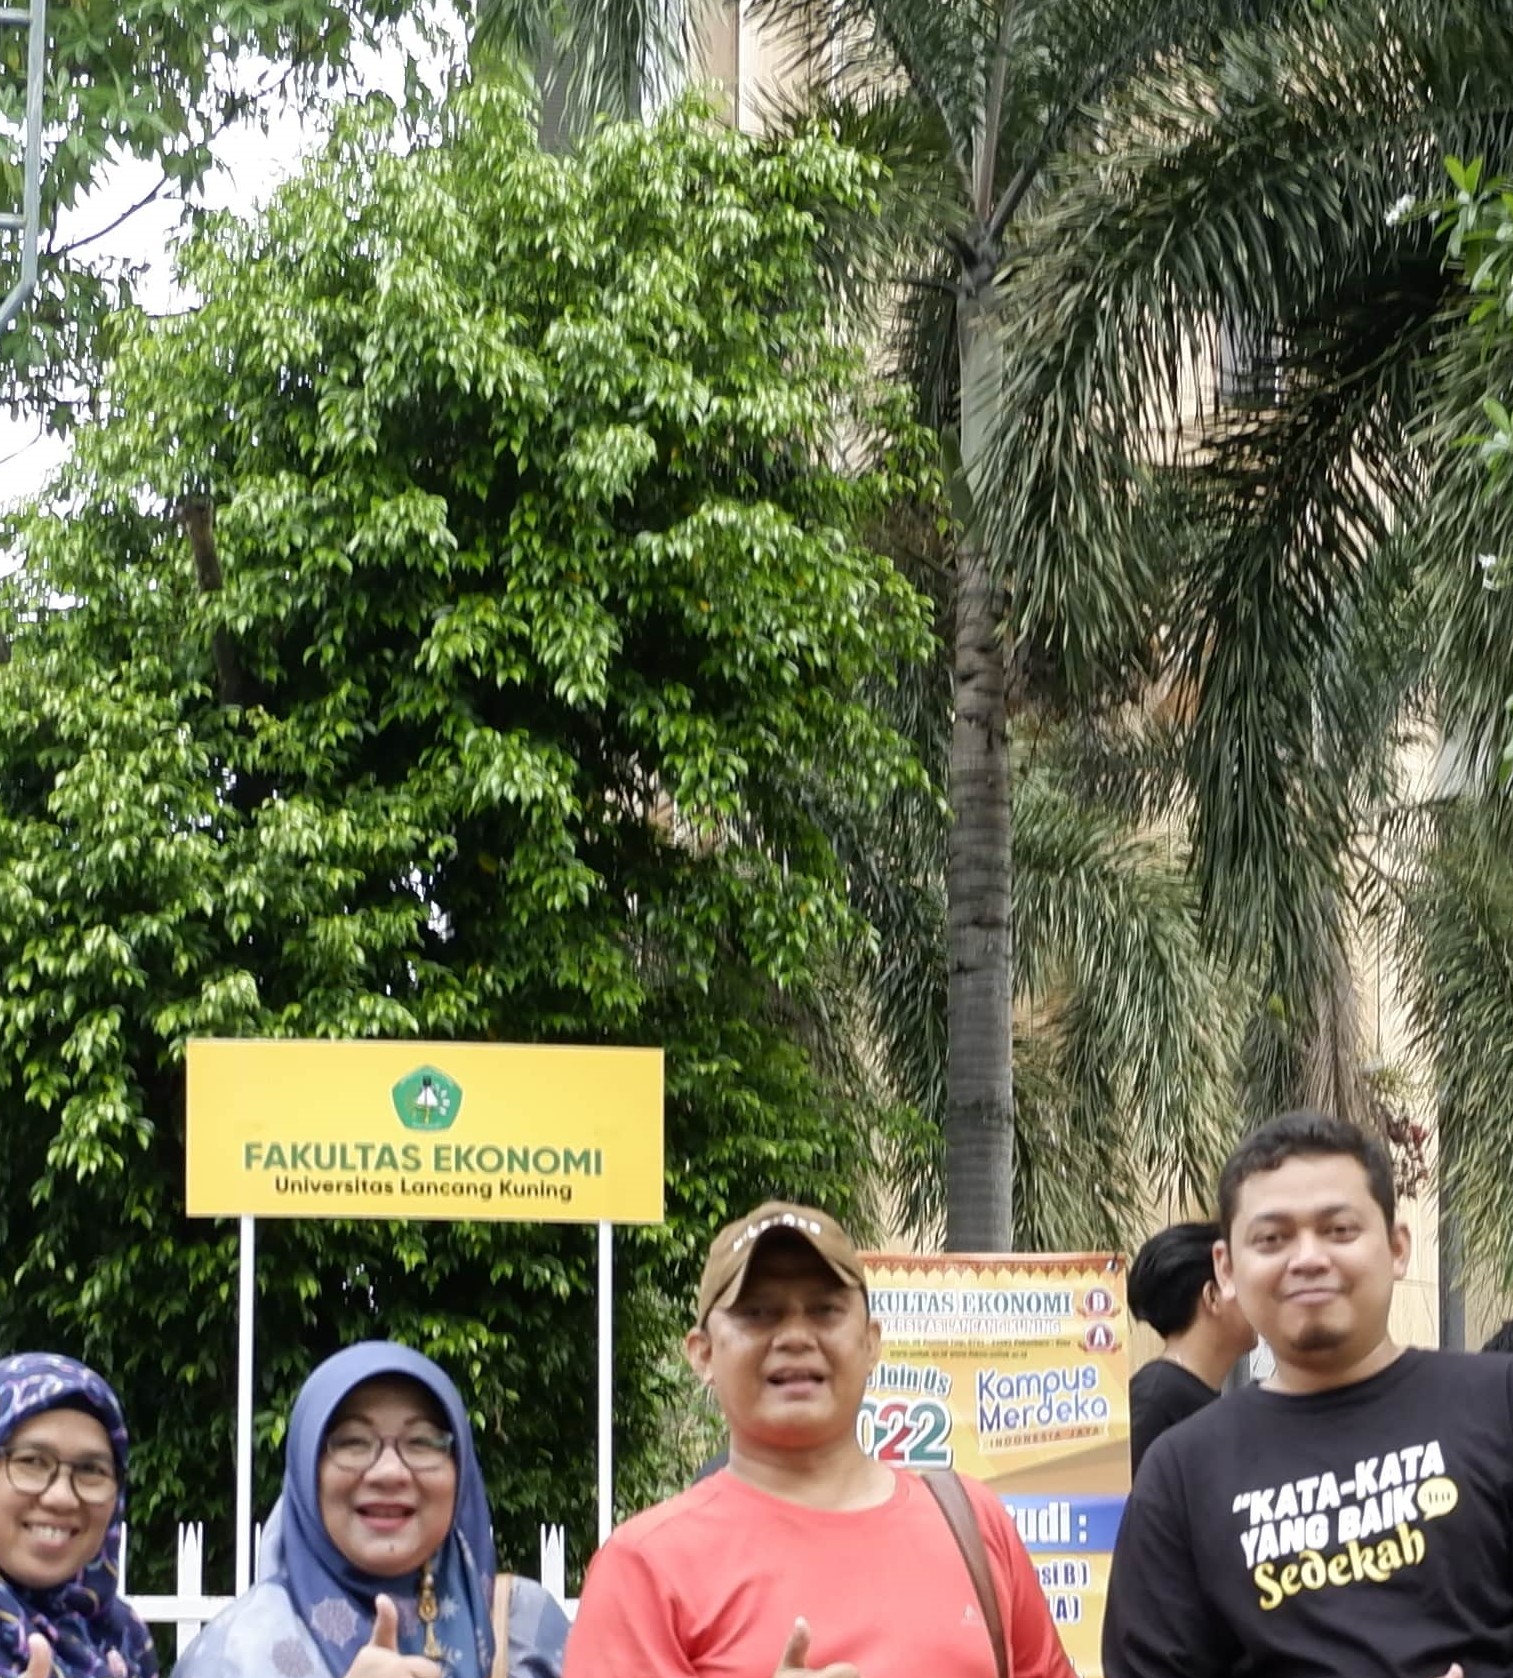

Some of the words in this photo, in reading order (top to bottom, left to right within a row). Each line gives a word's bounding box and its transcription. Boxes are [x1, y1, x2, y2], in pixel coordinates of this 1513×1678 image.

[244, 1142, 422, 1172] FAKULTAS
[433, 1144, 603, 1176] EKONOMI
[275, 1176, 394, 1195] Universitas
[401, 1177, 493, 1201] Lancang
[499, 1179, 573, 1202] Kuning
[961, 1290, 1072, 1315] EKONOMI
[1092, 1293, 1104, 1310] B
[1009, 1317, 1061, 1334] KUNING
[1093, 1327, 1106, 1345] A
[879, 1363, 919, 1390] Join
[923, 1365, 950, 1395] Us
[977, 1365, 1097, 1400] Kampus
[979, 1394, 1108, 1434] Merdeka
[989, 1430, 1062, 1449] INDONESIA
[1239, 1512, 1330, 1571] YANG
[1338, 1482, 1419, 1545] BAIK
[1254, 1521, 1426, 1611] Sedekah
